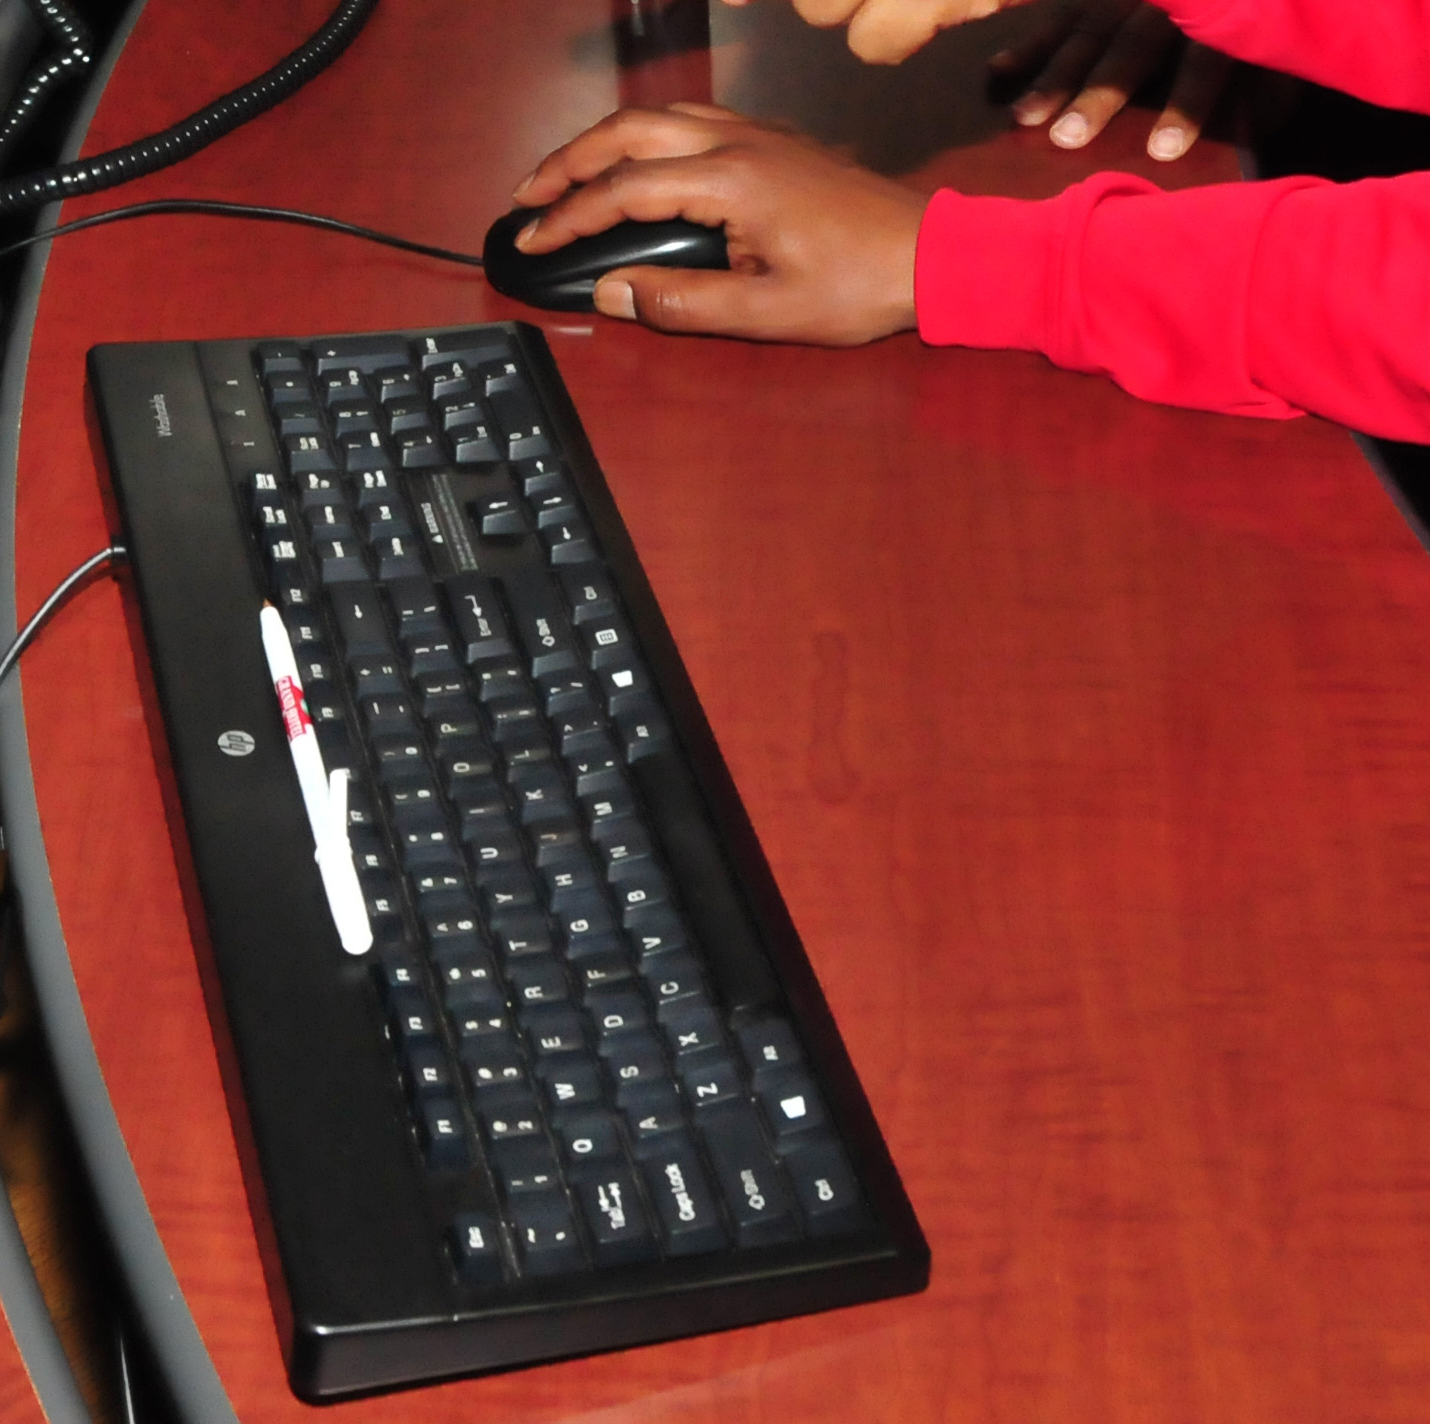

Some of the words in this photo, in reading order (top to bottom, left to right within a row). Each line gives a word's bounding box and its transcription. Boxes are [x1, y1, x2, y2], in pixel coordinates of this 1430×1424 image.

[525, 788, 544, 801] K
[593, 800, 613, 817] M
[480, 847, 499, 860] U
[610, 845, 629, 859] N
[554, 873, 573, 887] H
[495, 892, 514, 905] Y
[627, 889, 647, 903] B
[570, 919, 589, 933] G
[508, 939, 528, 952] T
[642, 936, 662, 950] V
[586, 969, 606, 980] F
[524, 985, 544, 999] R
[660, 980, 680, 994] C
[603, 1014, 623, 1029] D
[540, 1035, 562, 1050] E
[678, 1032, 700, 1047] X
[619, 1064, 639, 1079] S
[554, 1082, 576, 1100] W
[696, 1082, 719, 1098] Z
[638, 1116, 659, 1130] A
